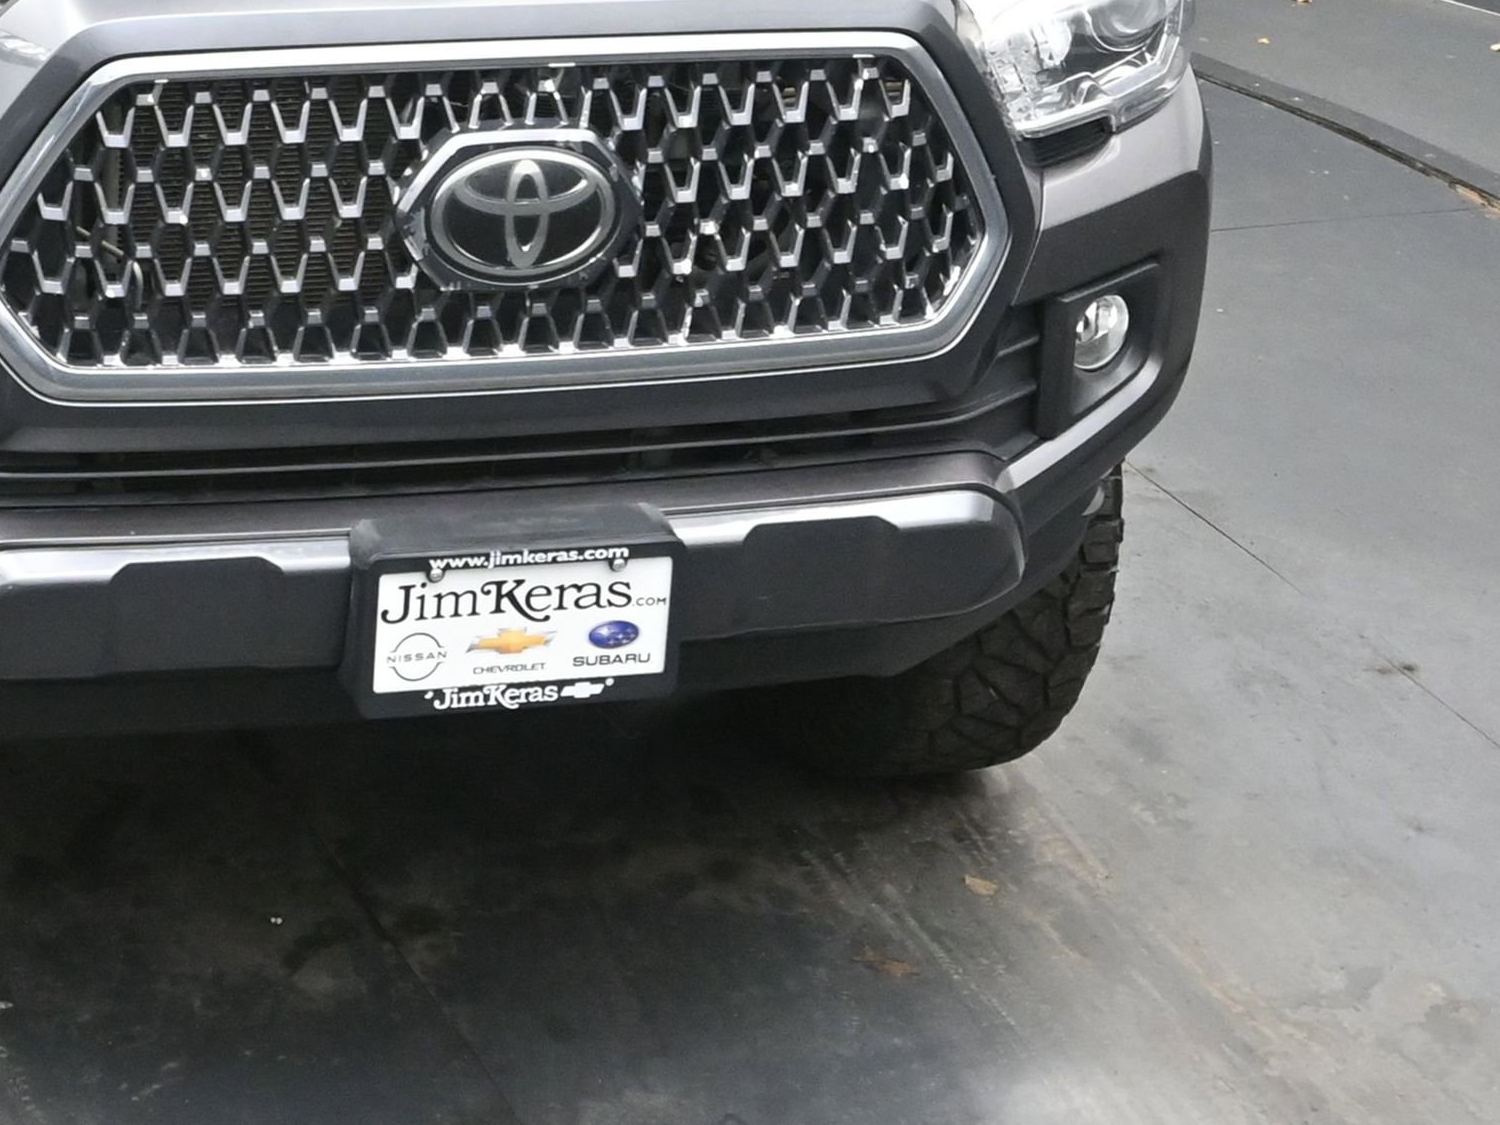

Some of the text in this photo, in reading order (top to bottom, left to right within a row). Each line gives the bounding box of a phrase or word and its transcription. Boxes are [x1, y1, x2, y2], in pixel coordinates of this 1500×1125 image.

[428, 546, 629, 569] www.jimkeras.com
[387, 651, 448, 664] NISSAN
[572, 652, 651, 667] SUBARU
[473, 662, 546, 675] CHEVROLET
